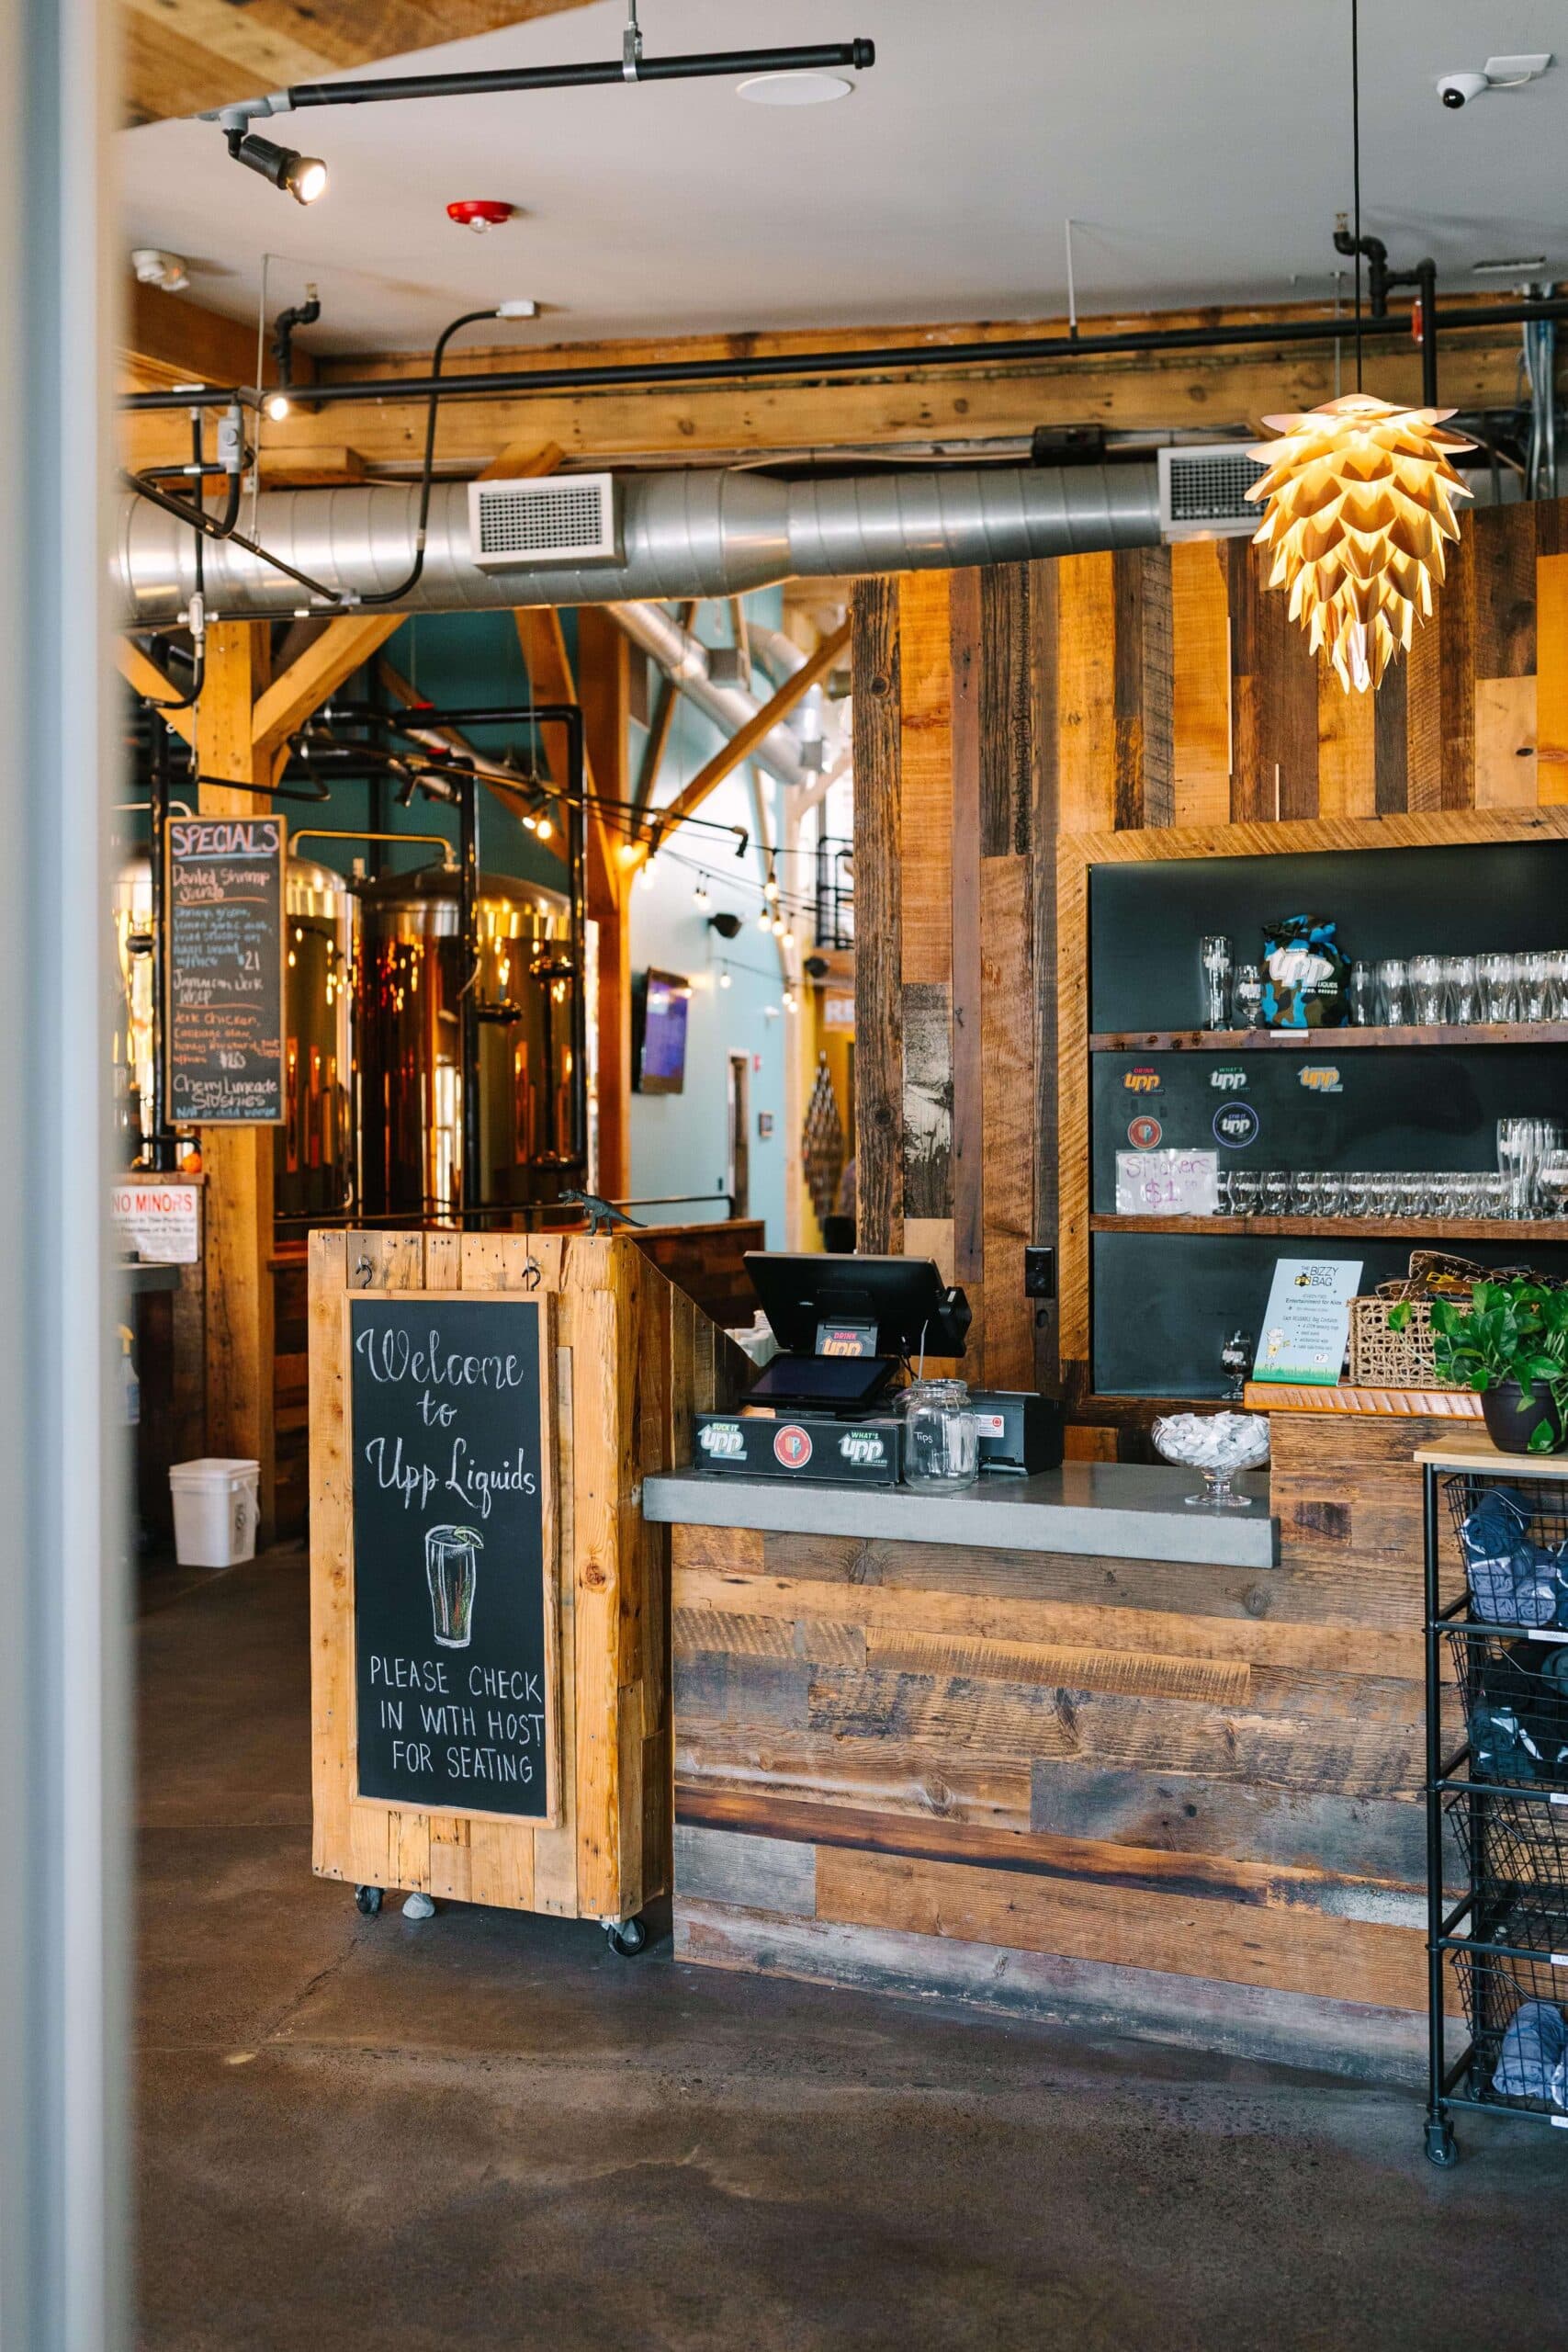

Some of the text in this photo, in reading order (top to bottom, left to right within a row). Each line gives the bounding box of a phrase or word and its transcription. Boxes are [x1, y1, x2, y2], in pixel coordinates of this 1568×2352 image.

[171, 822, 279, 856] SPECIALS
[174, 1073, 222, 1095] Cherry
[1122, 1071, 1161, 1092] upp
[1210, 1070, 1247, 1091] upp
[1221, 1117, 1251, 1134] upp
[136, 1193, 192, 1212] MINORS
[1311, 1276, 1333, 1286] BAG
[833, 1331, 857, 1340] DRINK
[355, 1329, 524, 1389] Welcome
[416, 1390, 457, 1427] to
[838, 1433, 884, 1463] upp
[852, 1431, 879, 1440] WHAT'S
[365, 1437, 536, 1519] Upp Liquids
[370, 1656, 542, 1702] PLEASE CHECK
[380, 1700, 545, 1747] IN WITH HOST
[393, 1740, 534, 1783] FOR SEATING
